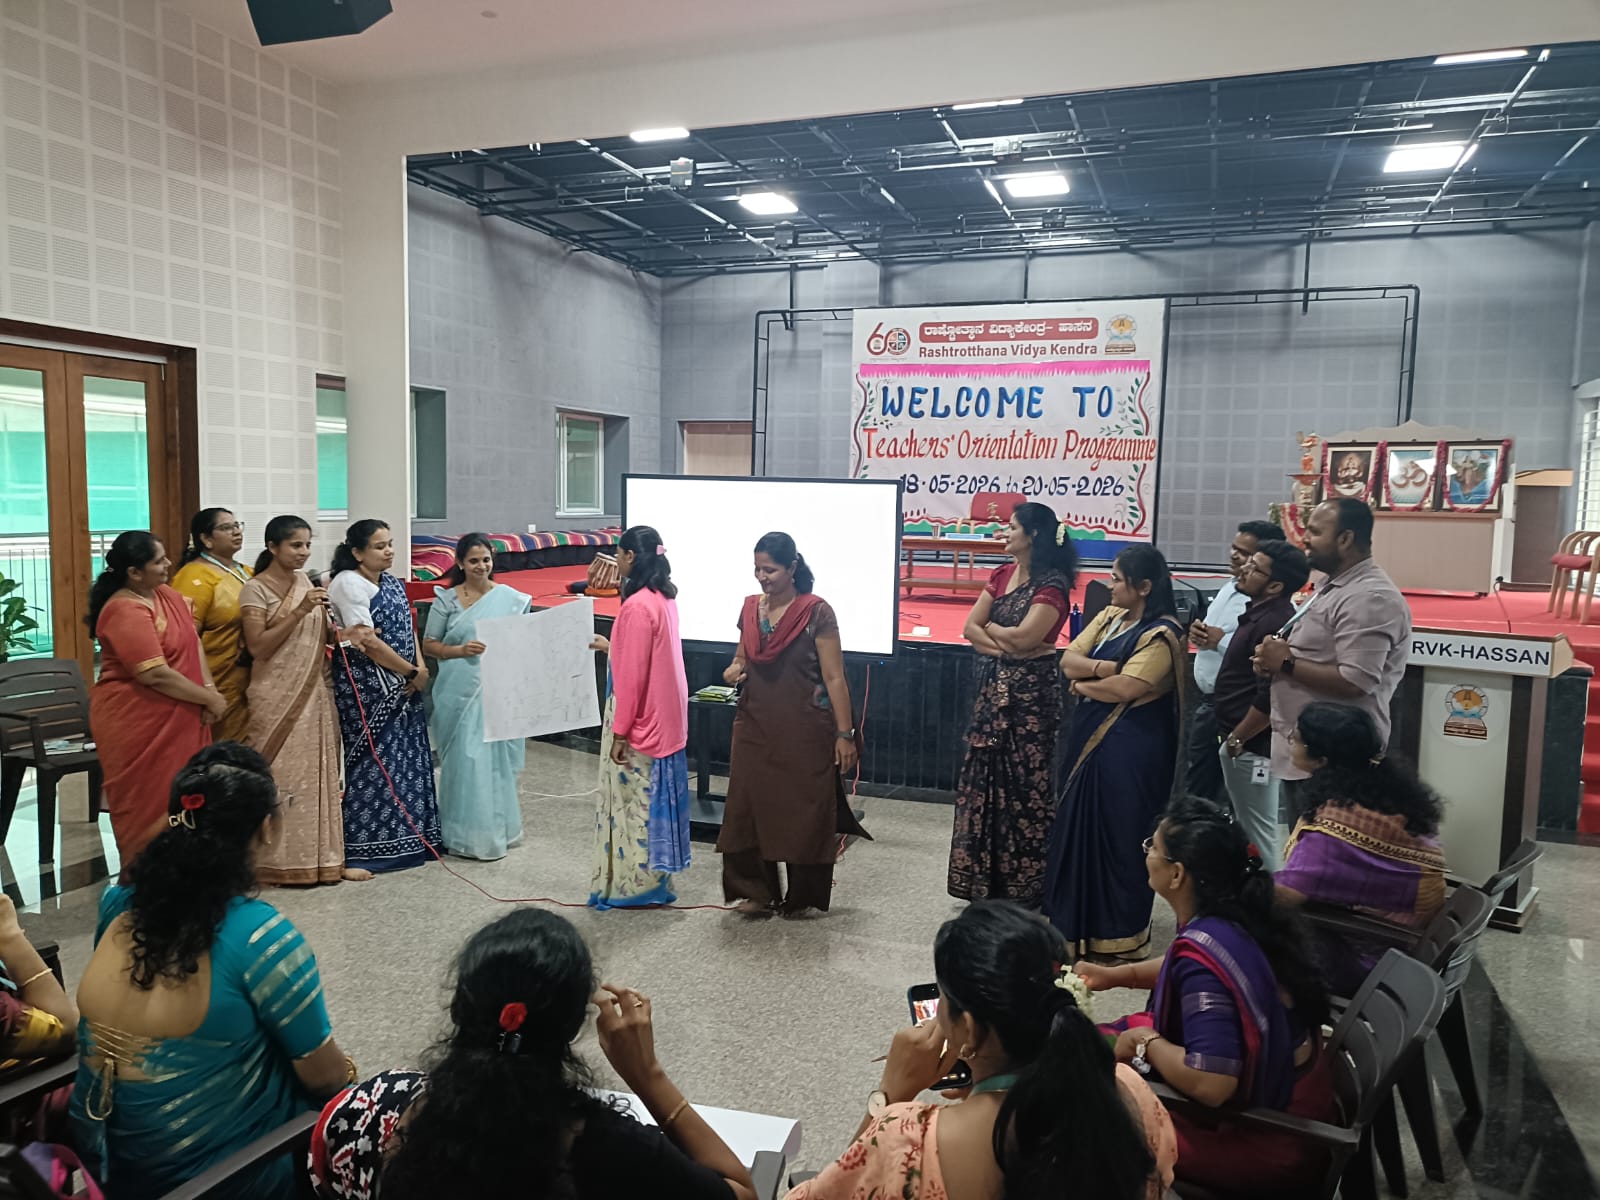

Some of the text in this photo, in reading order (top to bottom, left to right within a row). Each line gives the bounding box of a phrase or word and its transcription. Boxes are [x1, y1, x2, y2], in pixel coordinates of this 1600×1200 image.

[919, 345, 1007, 358] Rashtrotthana
[1010, 344, 1047, 358] Vidya
[1050, 342, 1097, 355] Kendra
[881, 385, 1114, 419] WELCOME TO
[958, 428, 1058, 459] Orientation
[1063, 429, 1156, 471] Programme
[1006, 475, 1019, 493] to
[1412, 640, 1550, 666] RVK-HASSAN
